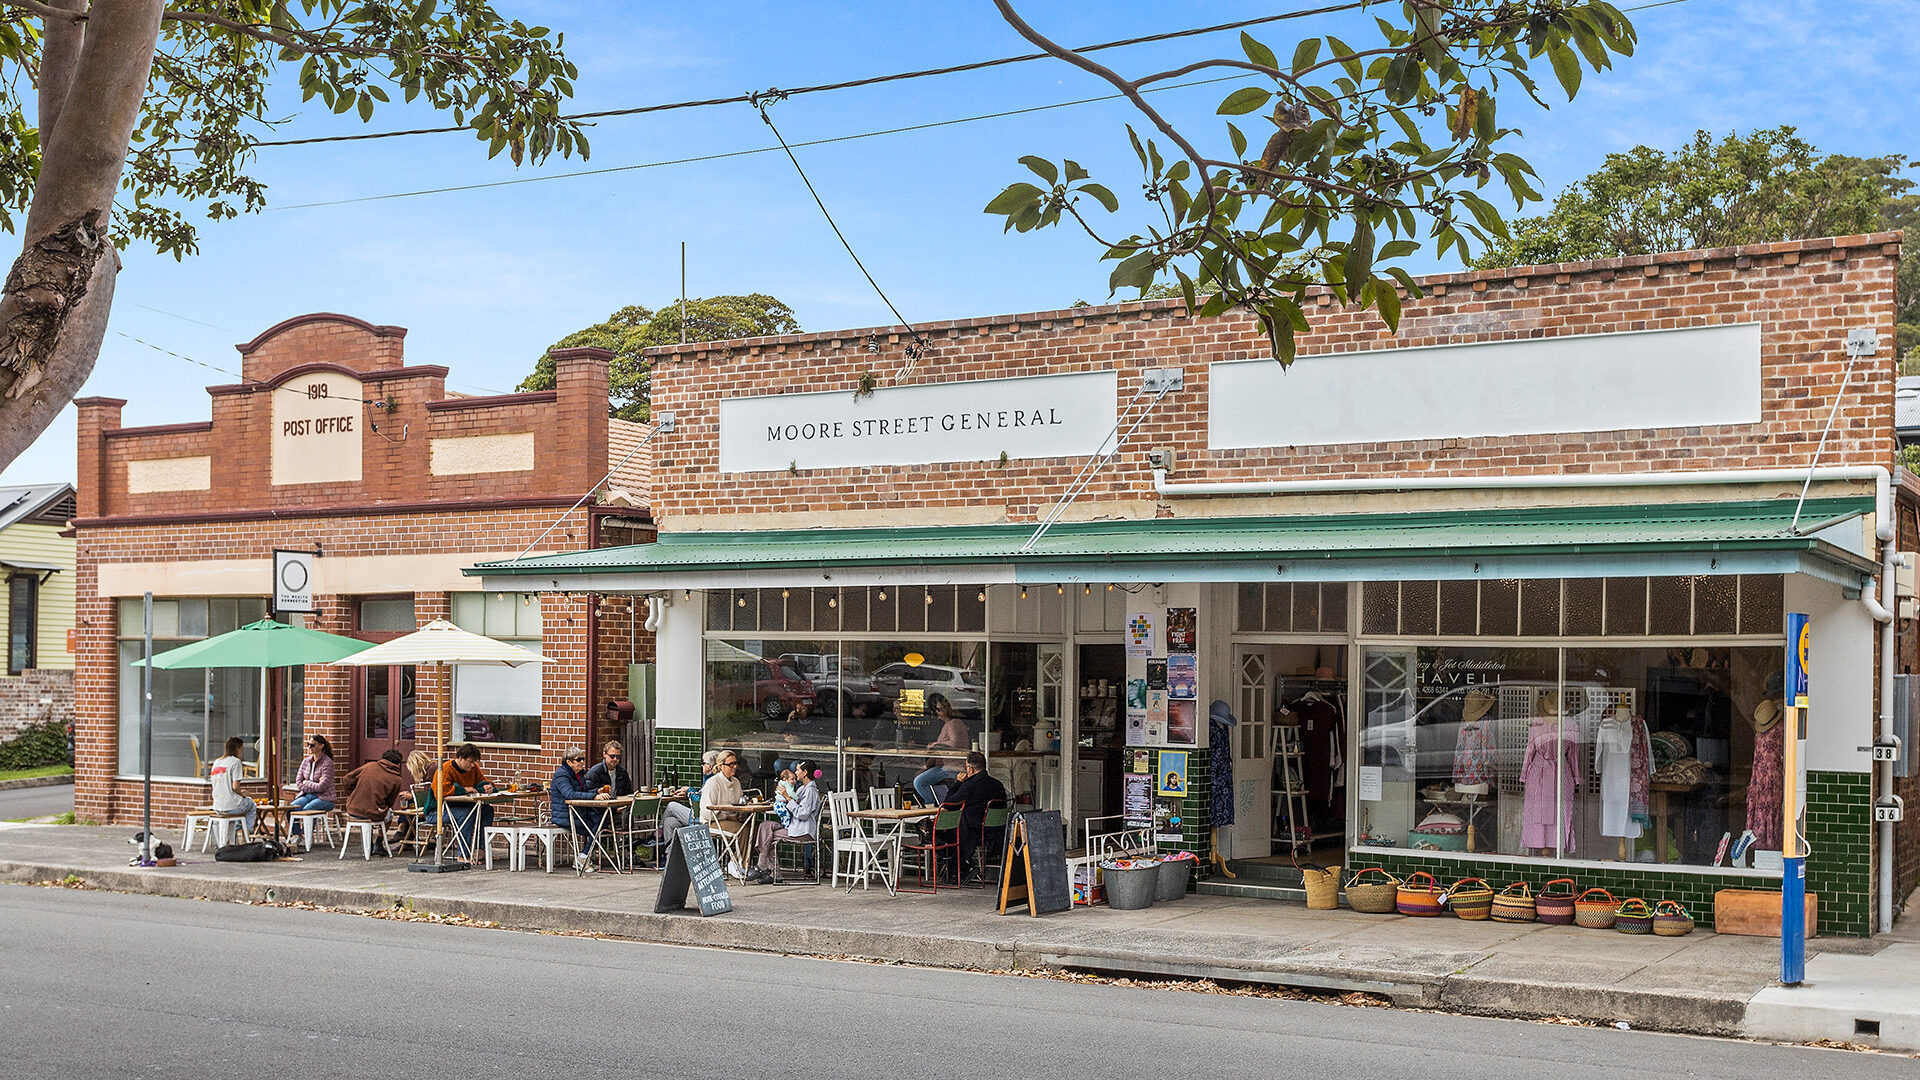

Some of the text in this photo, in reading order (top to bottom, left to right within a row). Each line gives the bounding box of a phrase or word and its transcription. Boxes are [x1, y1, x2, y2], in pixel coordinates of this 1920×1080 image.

[308, 383, 328, 400] 1919
[284, 416, 353, 436] POST OFFICE
[767, 408, 1062, 441] MOORE STREET GENERAL
[1416, 660, 1431, 672] uzy
[1457, 659, 1506, 670] Middleton
[1876, 748, 1892, 759] 38
[1879, 809, 1894, 820] 36
